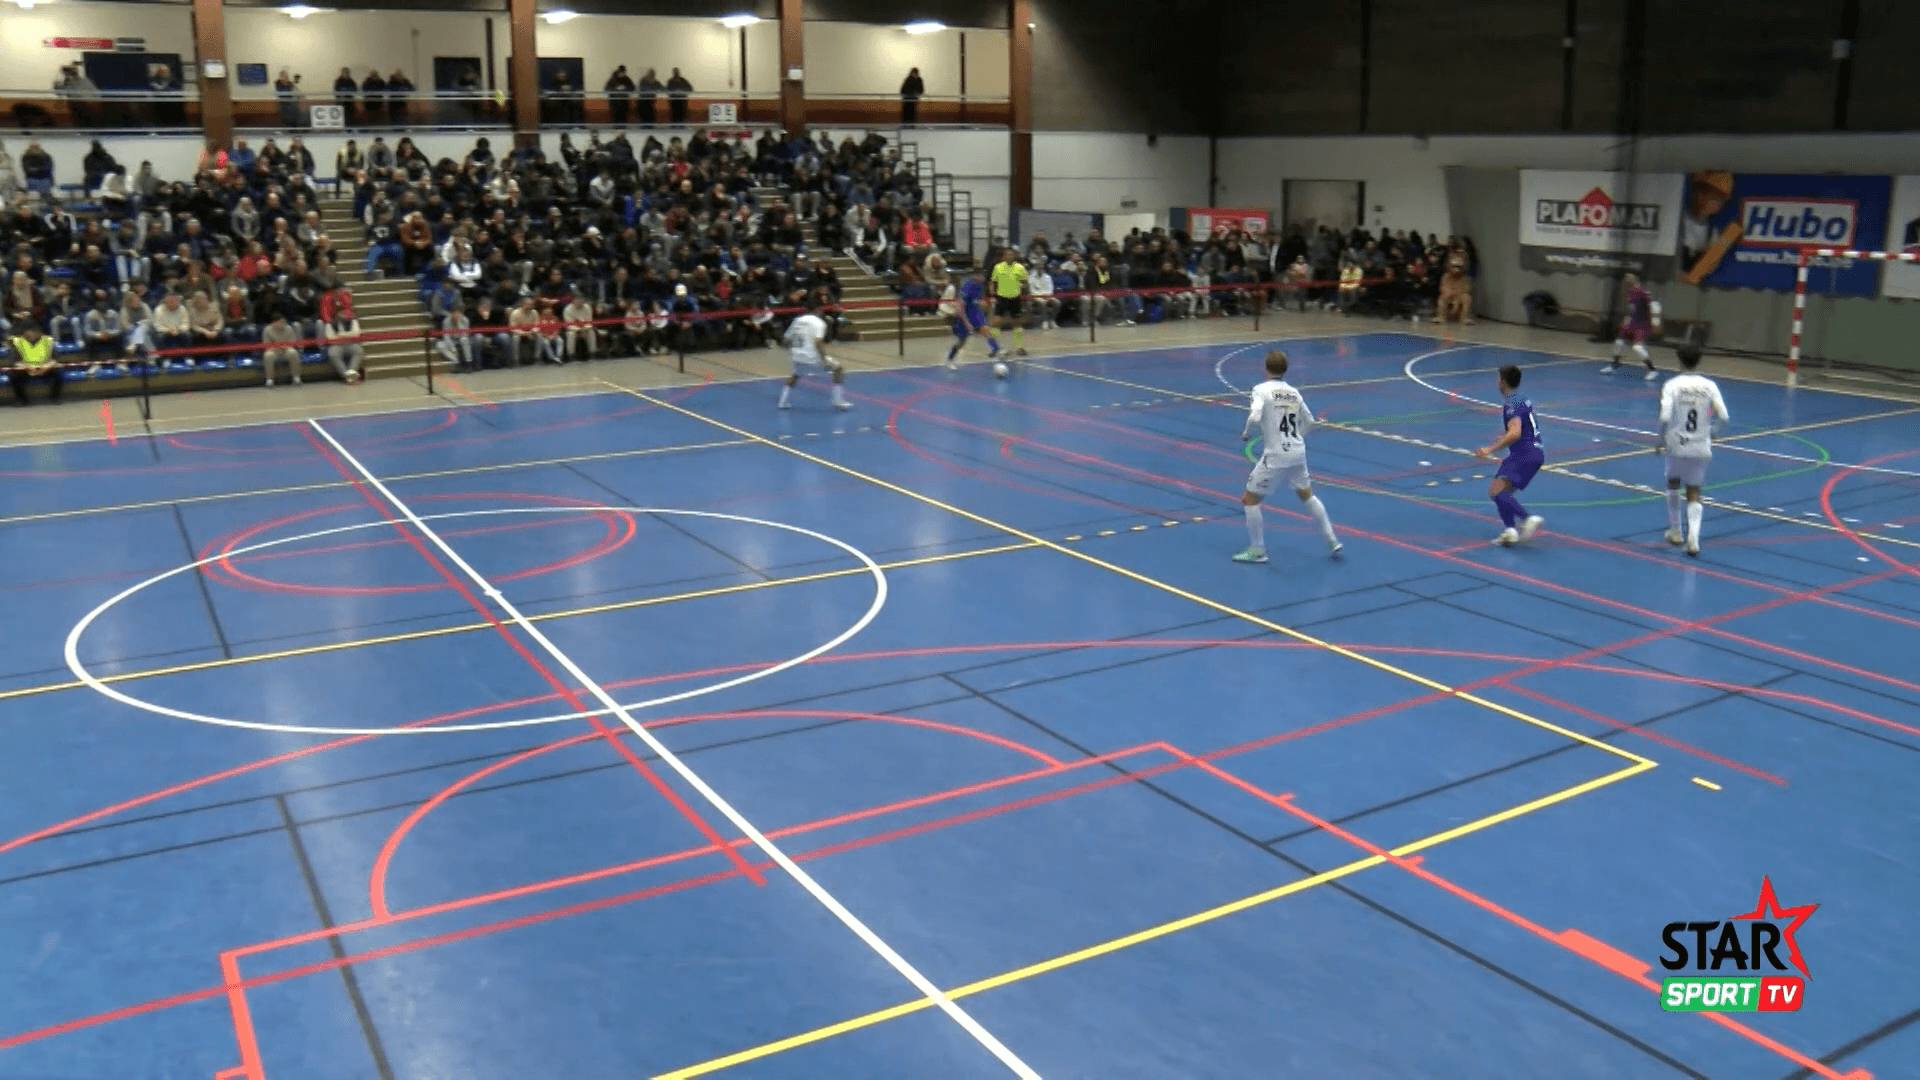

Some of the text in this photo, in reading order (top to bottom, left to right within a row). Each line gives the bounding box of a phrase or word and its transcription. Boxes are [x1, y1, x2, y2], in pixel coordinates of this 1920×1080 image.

[1744, 205, 1848, 240] Hubo
[1280, 413, 1297, 438] 45
[1686, 409, 1698, 432] 8
